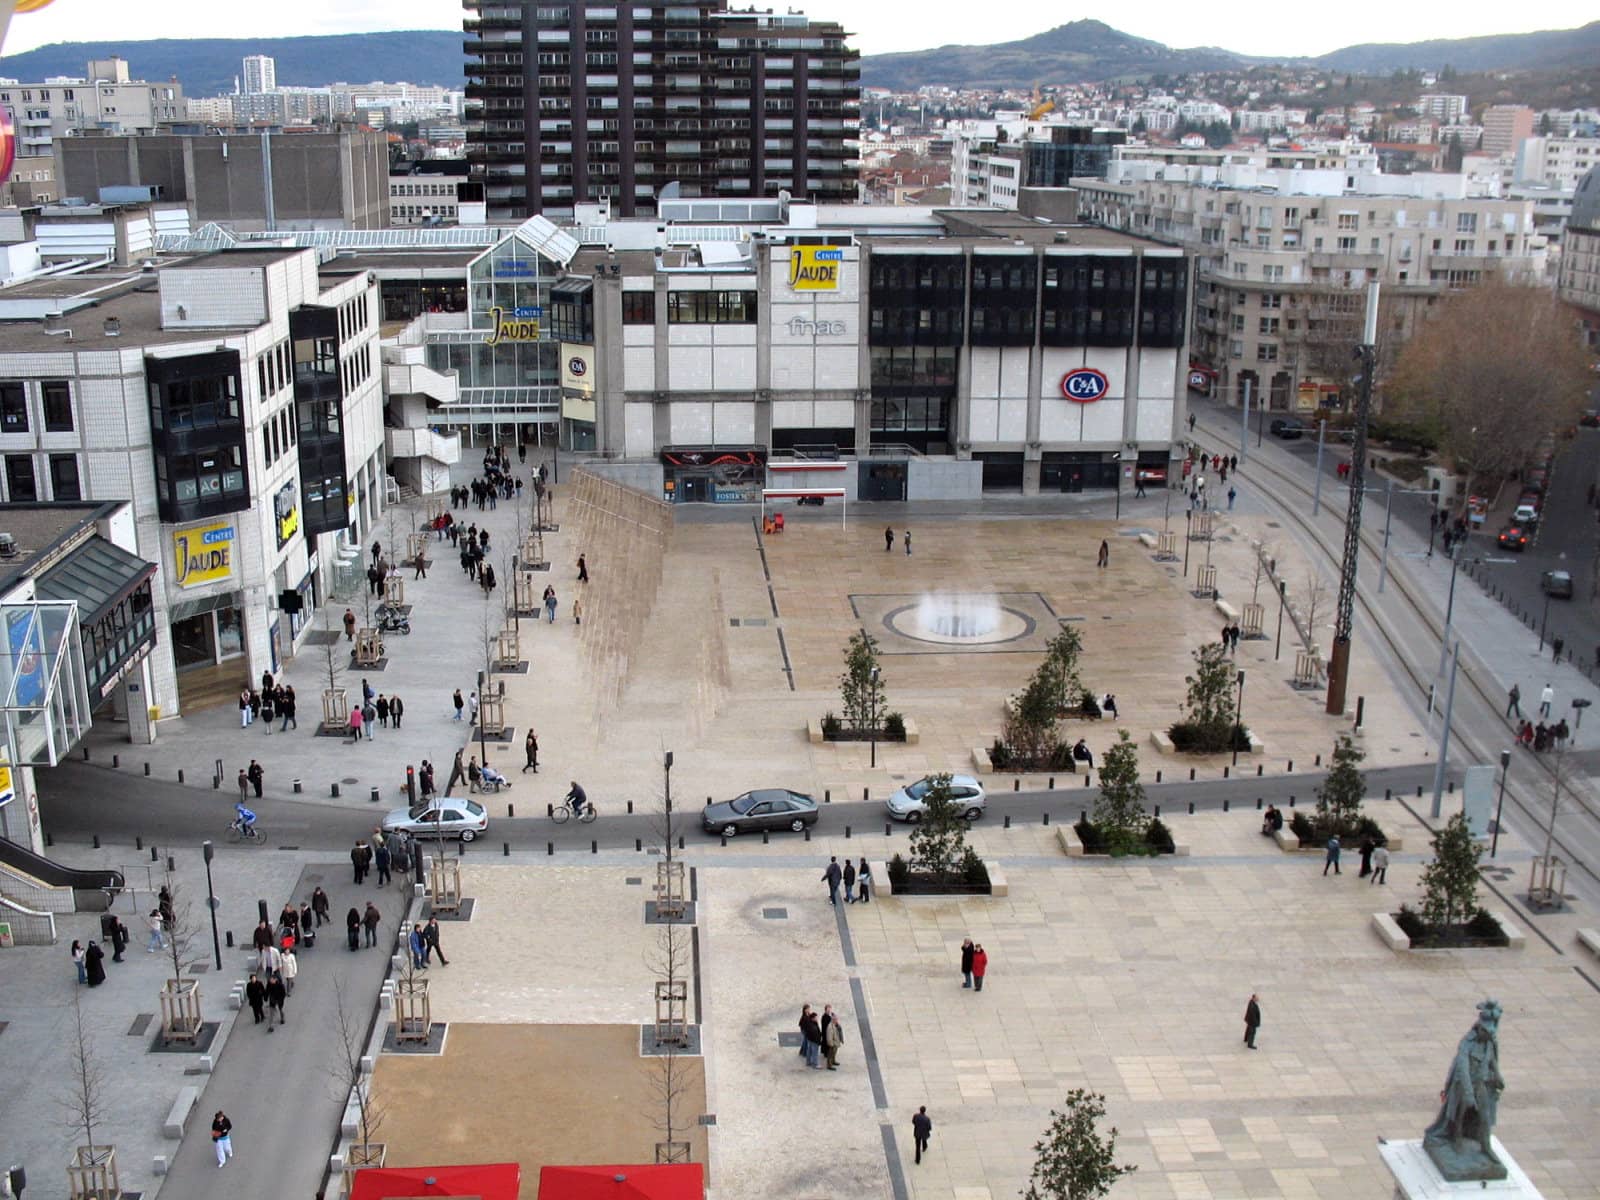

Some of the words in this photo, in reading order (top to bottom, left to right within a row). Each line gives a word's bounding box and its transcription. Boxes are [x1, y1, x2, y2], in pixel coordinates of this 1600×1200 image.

[787, 250, 836, 286] JAUDE
[486, 307, 538, 344] JAUDE
[785, 316, 846, 336] fnac
[1069, 376, 1100, 393] C&A
[176, 536, 229, 584] JAUDE
